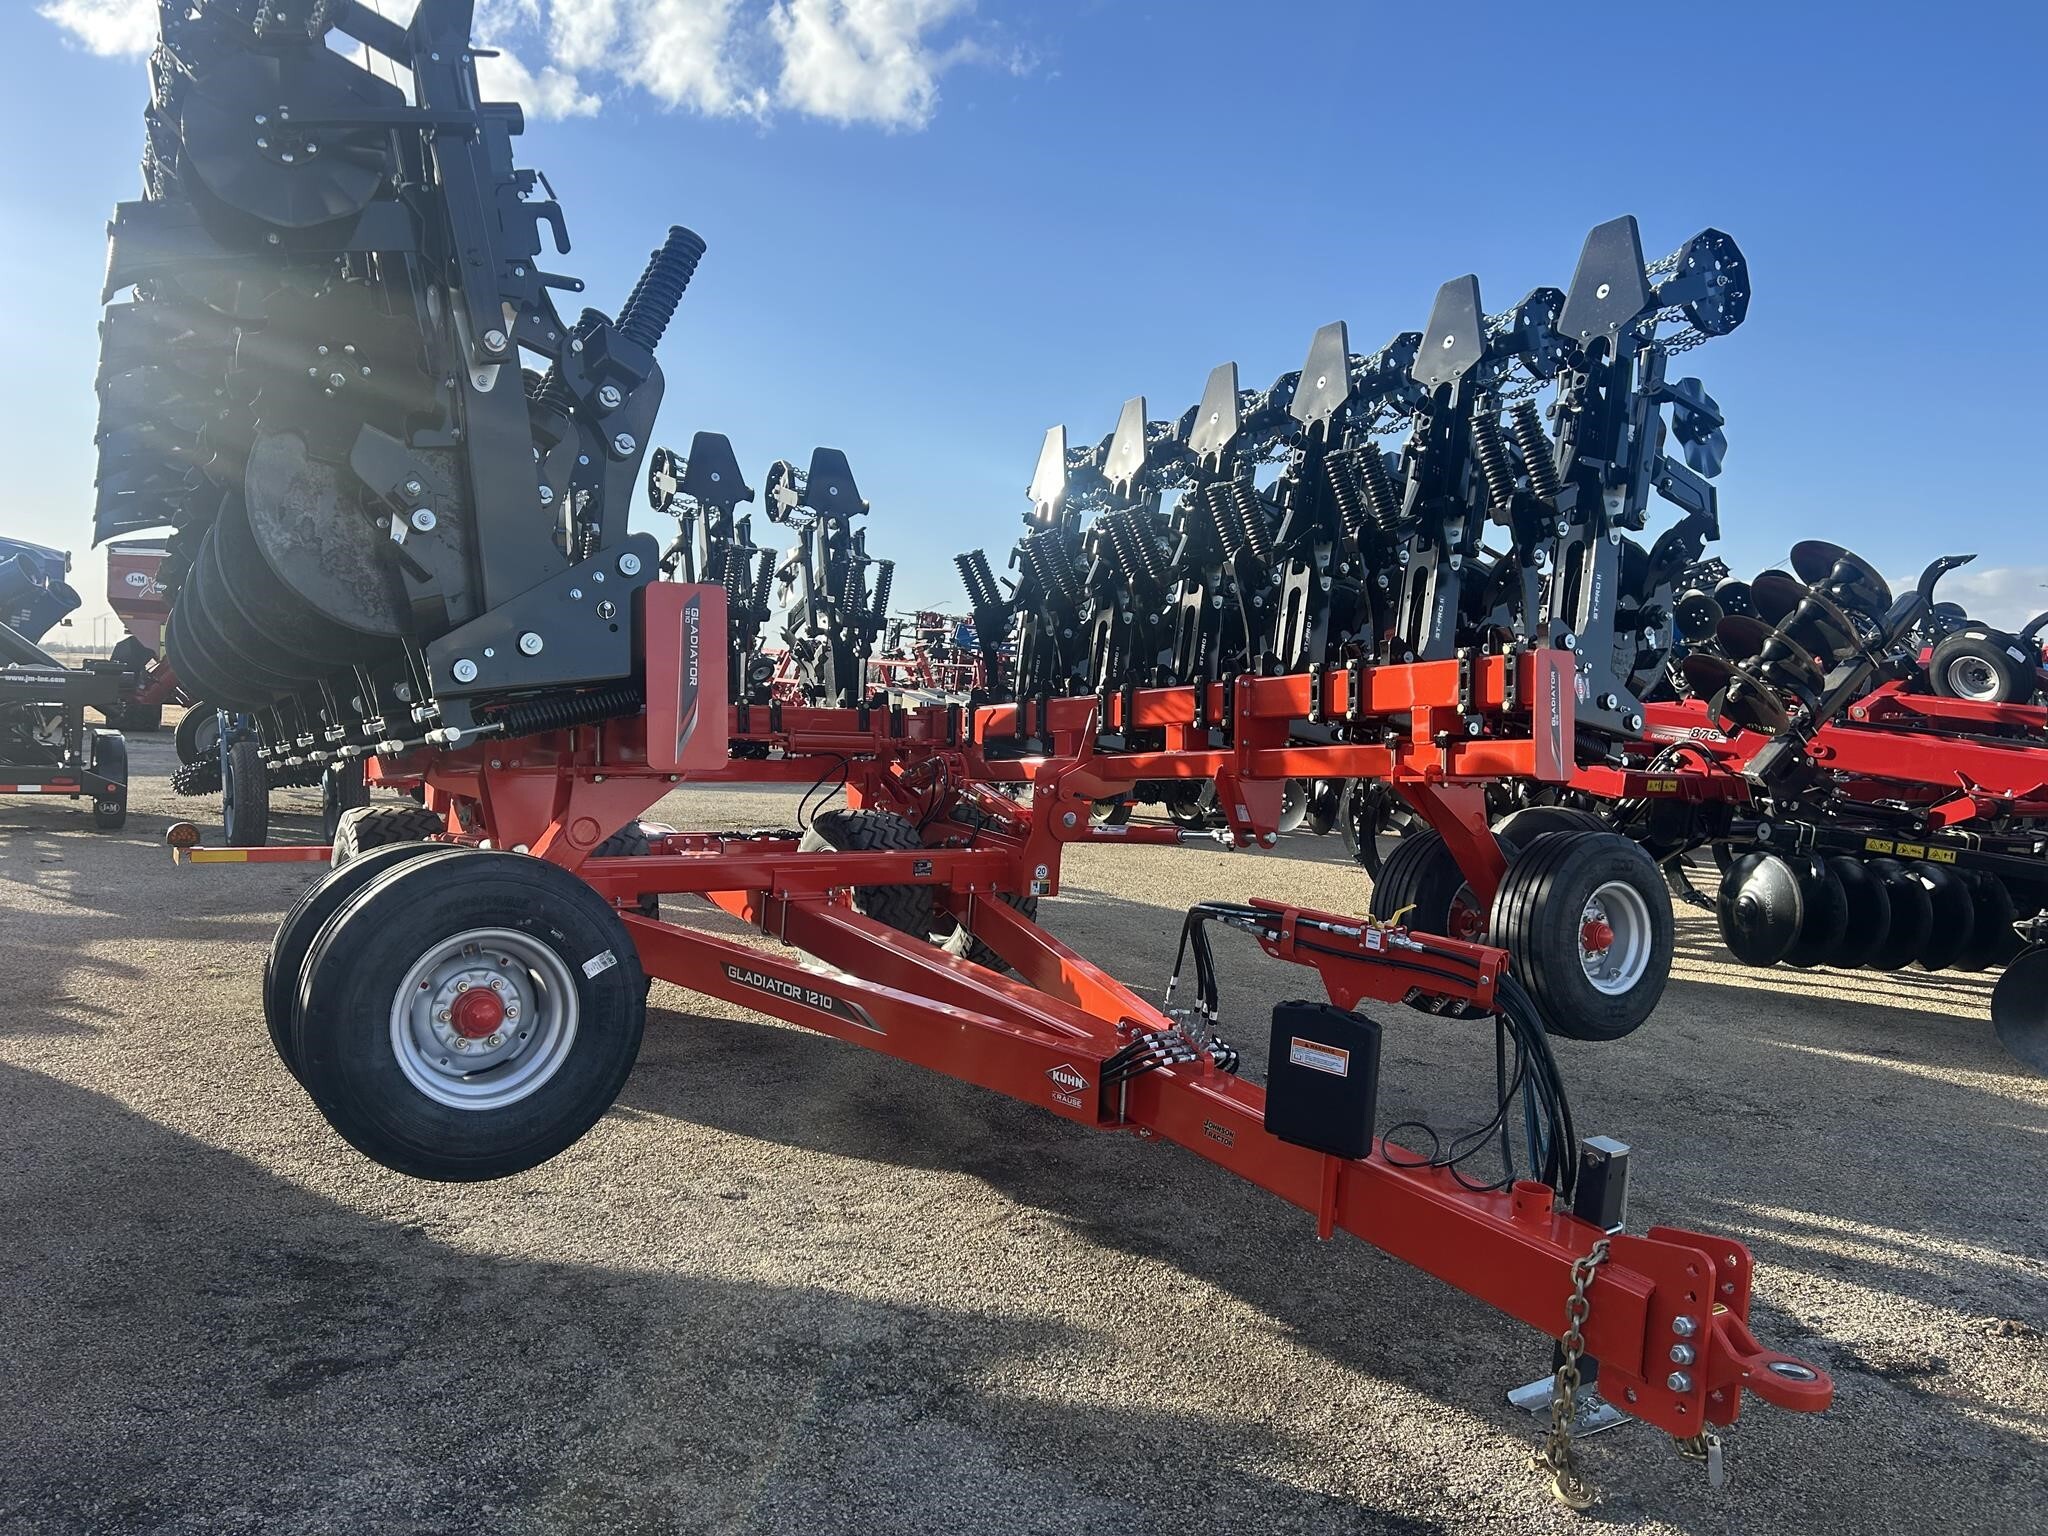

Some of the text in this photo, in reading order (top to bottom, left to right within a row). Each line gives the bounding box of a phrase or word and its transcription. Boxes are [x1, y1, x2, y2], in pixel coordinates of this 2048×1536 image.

[689, 607, 699, 687] GLADIATOR
[1689, 727, 1721, 741] 875
[1037, 867, 1046, 875] 20
[728, 965, 833, 1009] GLADIATOR 1210
[1052, 1070, 1083, 1089] KUHN
[1051, 1092, 1082, 1108] KRAUSE
[1203, 1120, 1235, 1138] JOHNSON
[1203, 1126, 1234, 1148] TRACTOR
